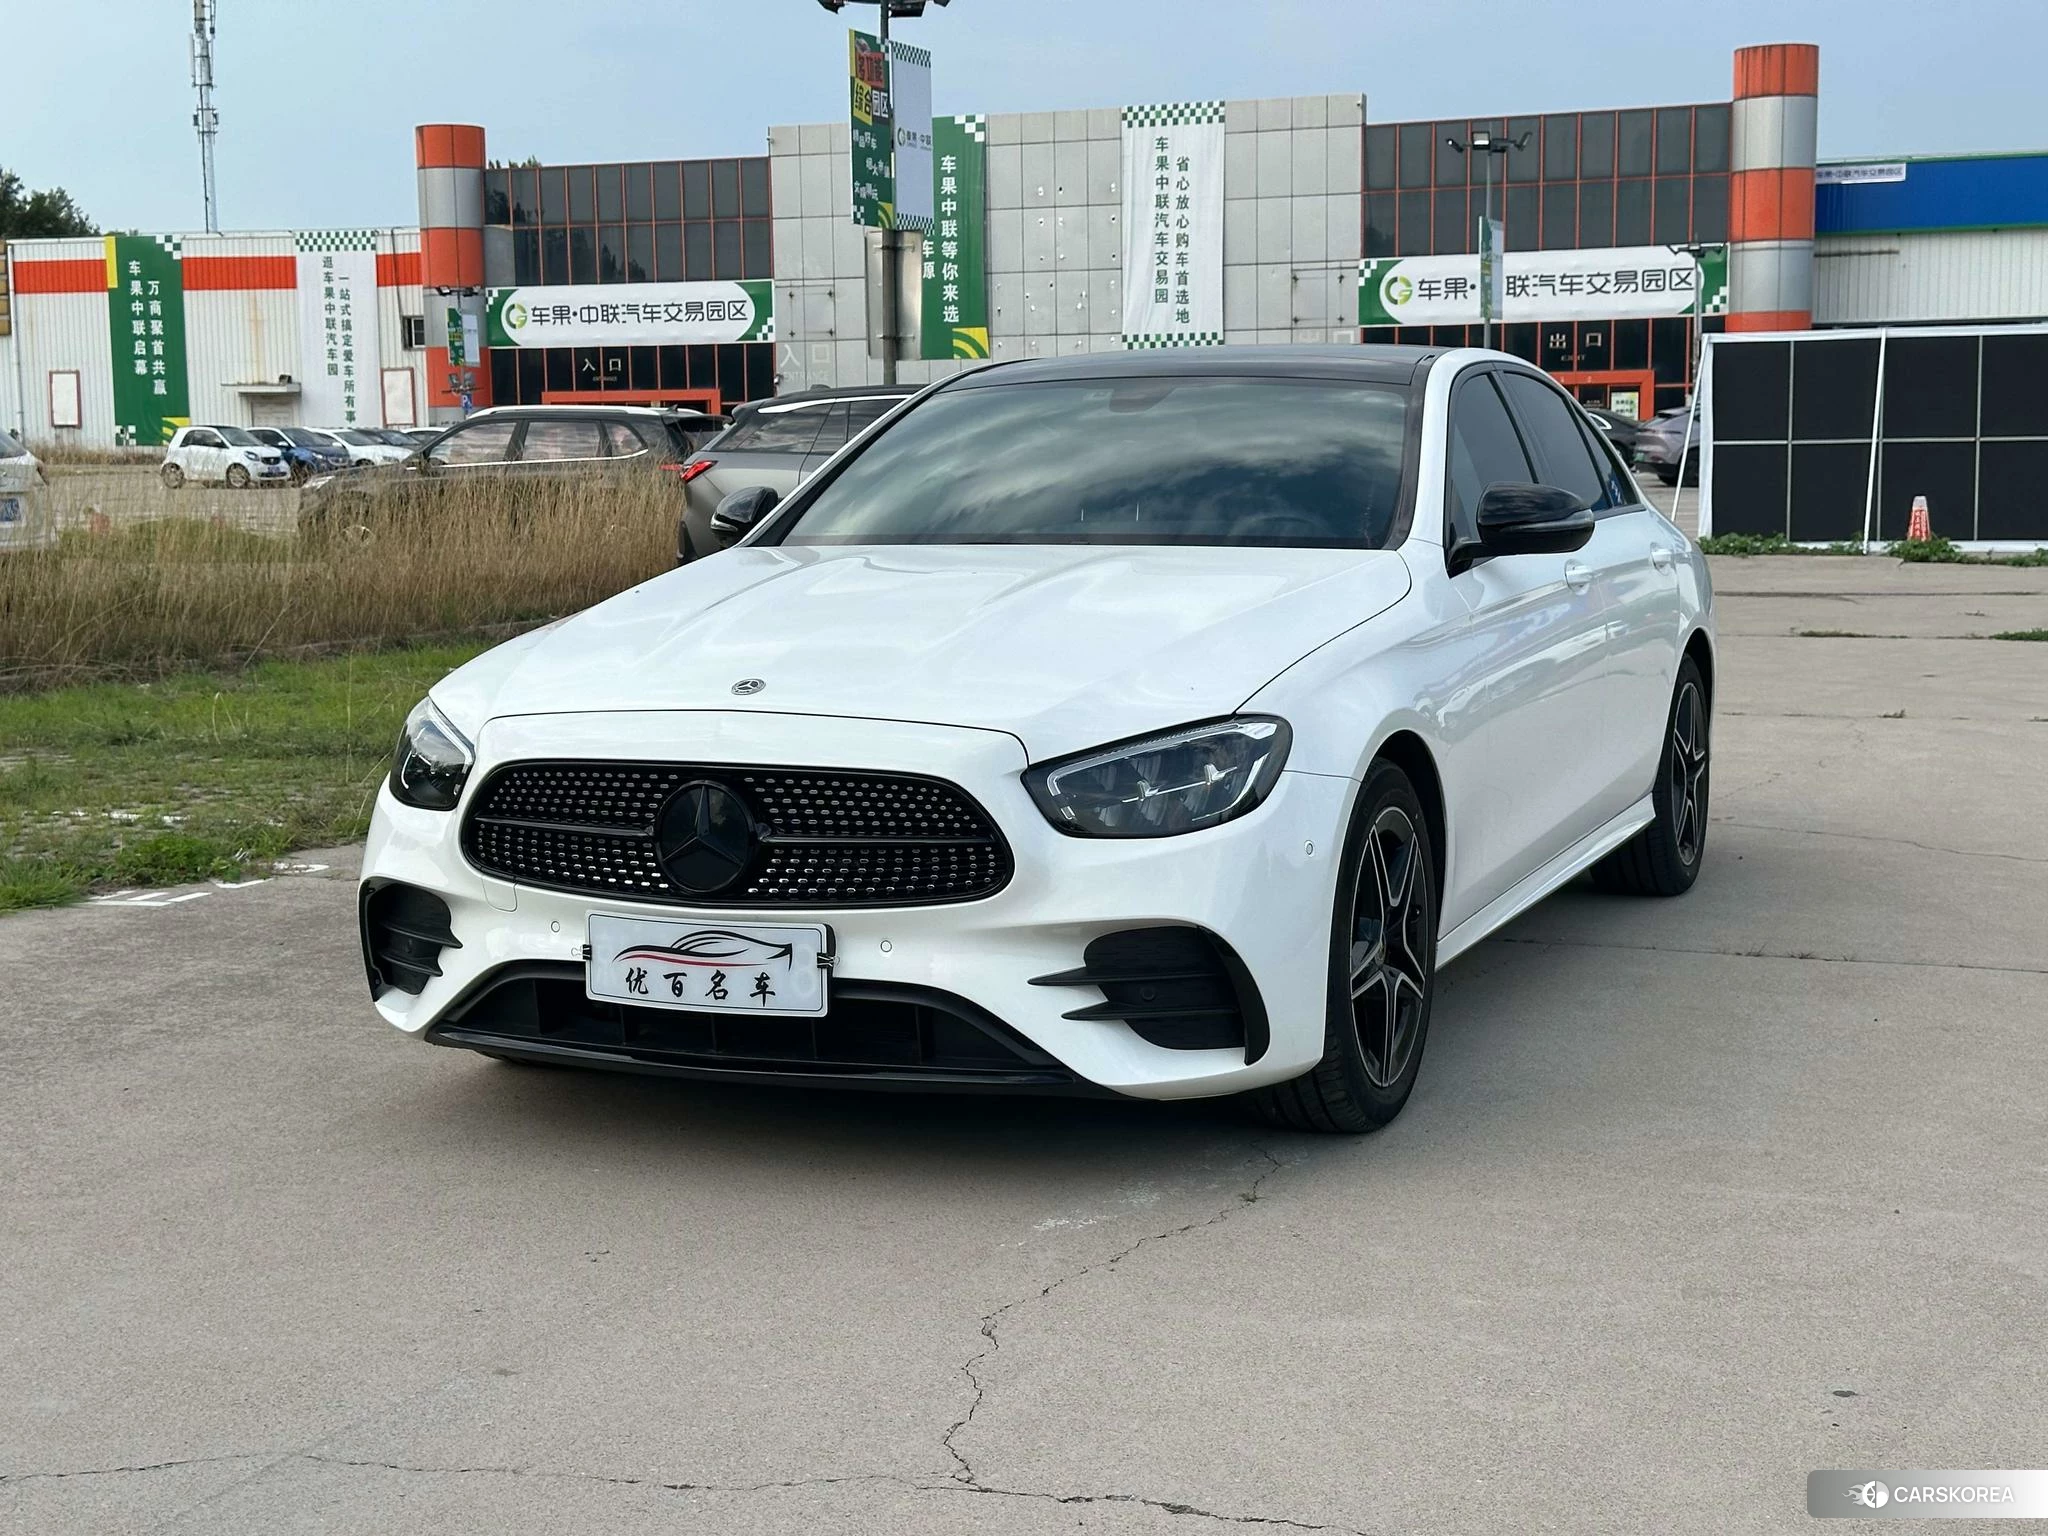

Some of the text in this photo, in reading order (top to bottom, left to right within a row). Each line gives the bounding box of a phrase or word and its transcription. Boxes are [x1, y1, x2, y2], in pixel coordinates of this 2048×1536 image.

[854, 82, 889, 119] 综合园区
[941, 154, 959, 323] 车果中联等你来选
[1154, 136, 1169, 303] 车果中联汽车交易园
[1175, 156, 1190, 324] 省心放心购车首选地
[129, 260, 148, 375] 车果中联启幕
[322, 255, 339, 376] 逛车果中联汽车园
[531, 299, 748, 326] 车果·中联汽车交易园区
[1417, 267, 1694, 301] 车果·联汽车交易园区
[148, 280, 167, 395] 万商聚首共赢
[338, 275, 357, 423] 一站式搞定爱车所有事
[581, 358, 622, 372] 入口
[780, 344, 831, 368] 入口
[1549, 333, 1602, 349] 出口
[626, 967, 776, 1007] 优百名车
